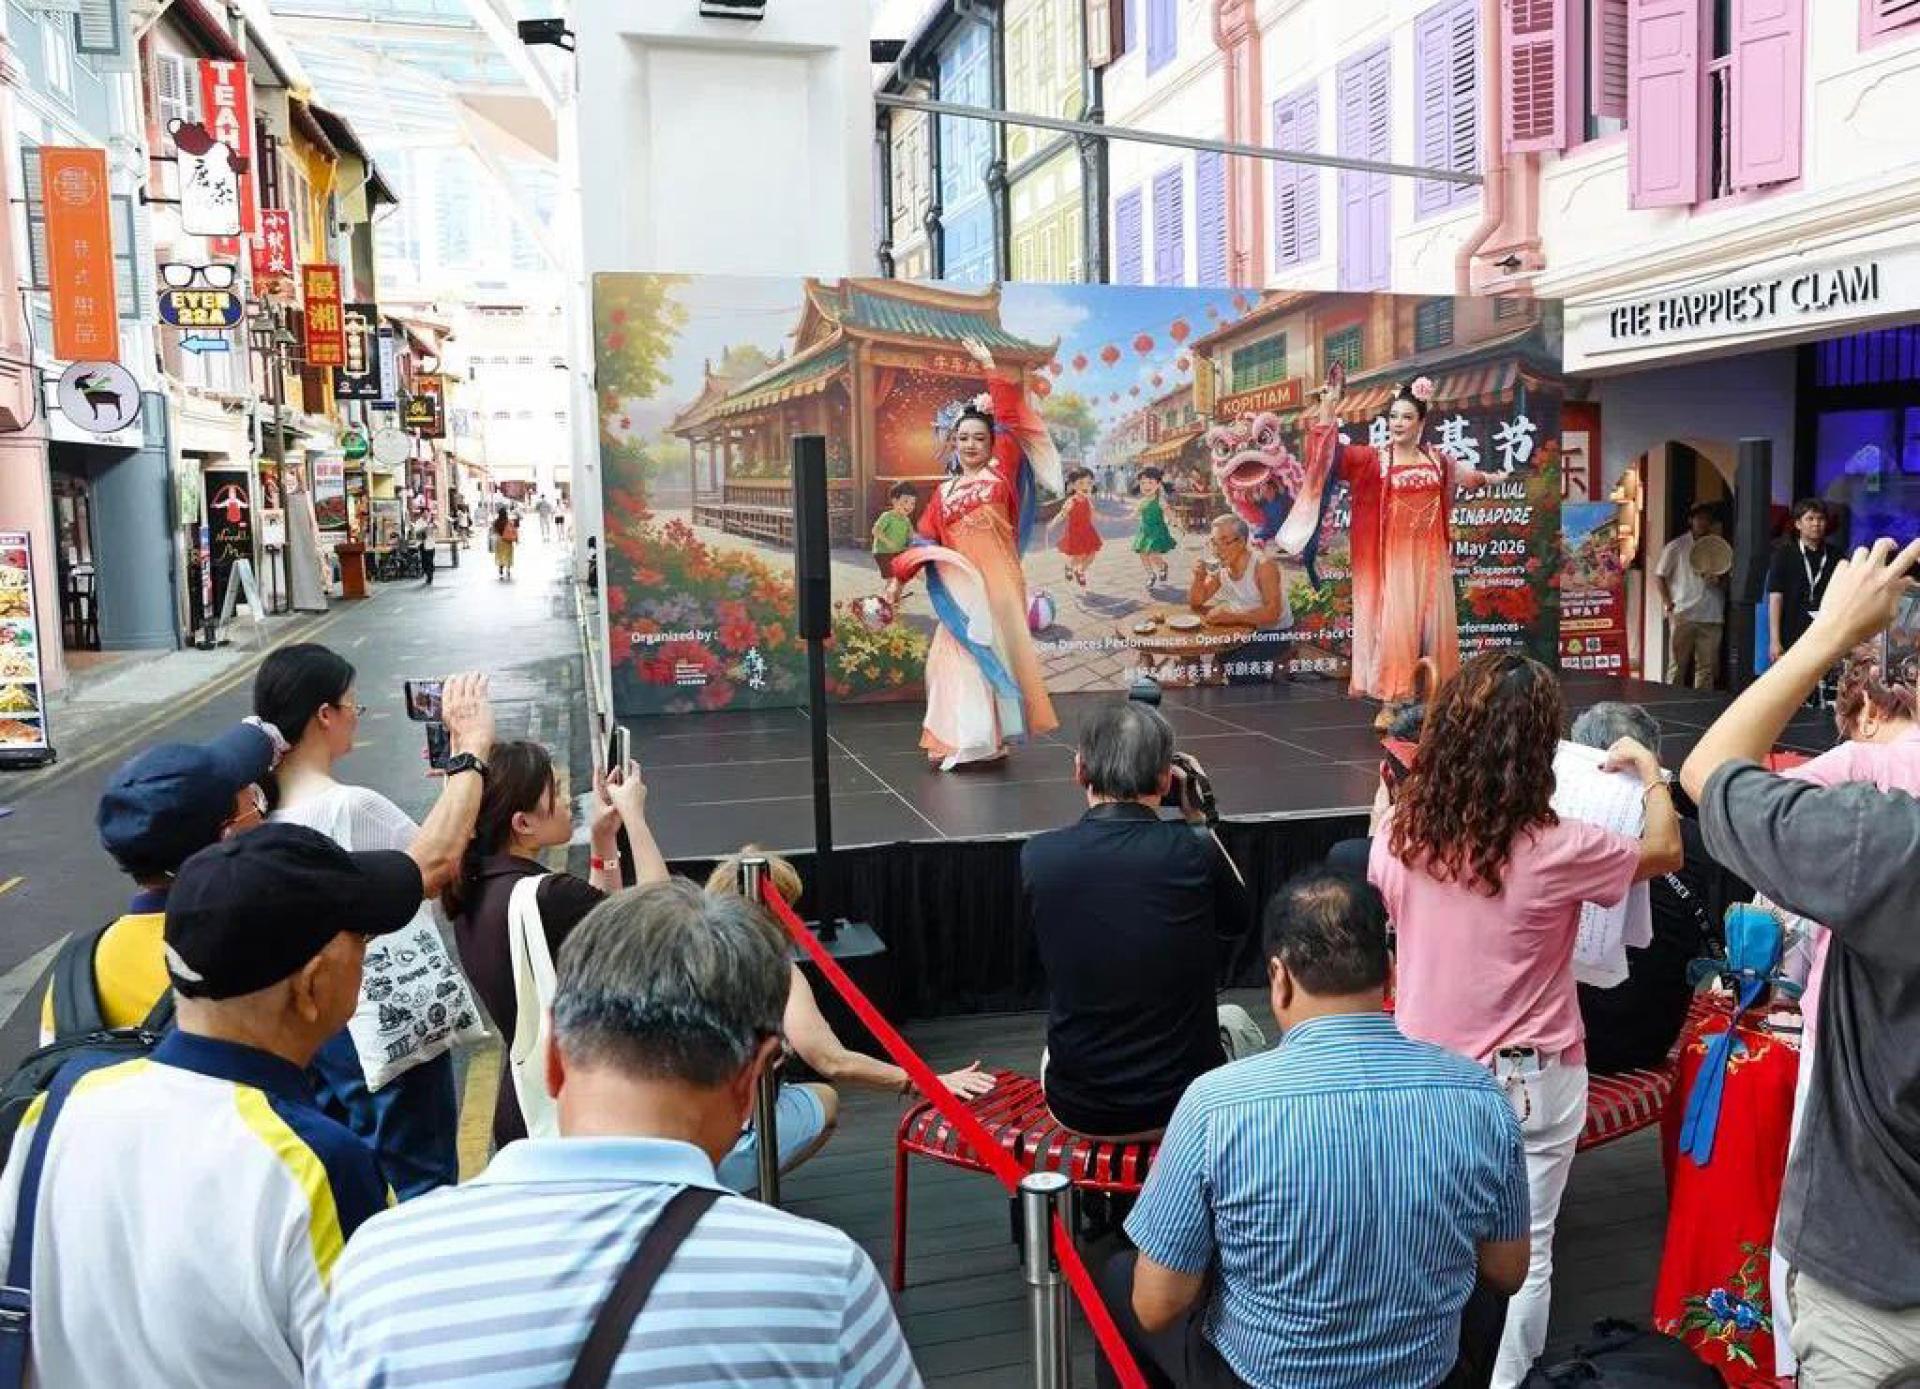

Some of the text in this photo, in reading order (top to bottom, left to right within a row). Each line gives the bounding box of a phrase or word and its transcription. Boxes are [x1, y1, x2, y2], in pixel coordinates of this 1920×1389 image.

[1609, 263, 1880, 338] THE HAPPIEST CLAM
[1223, 387, 1291, 415] KOPITIAM
[1449, 506, 1534, 526] SINGAPORE
[1456, 541, 1487, 558] May
[1490, 539, 1525, 554] 2026
[631, 630, 694, 646] Organized
[697, 629, 711, 643] by
[1196, 634, 1230, 645] Opera
[1233, 629, 1312, 643] Performances
[1319, 628, 1345, 639] Face
